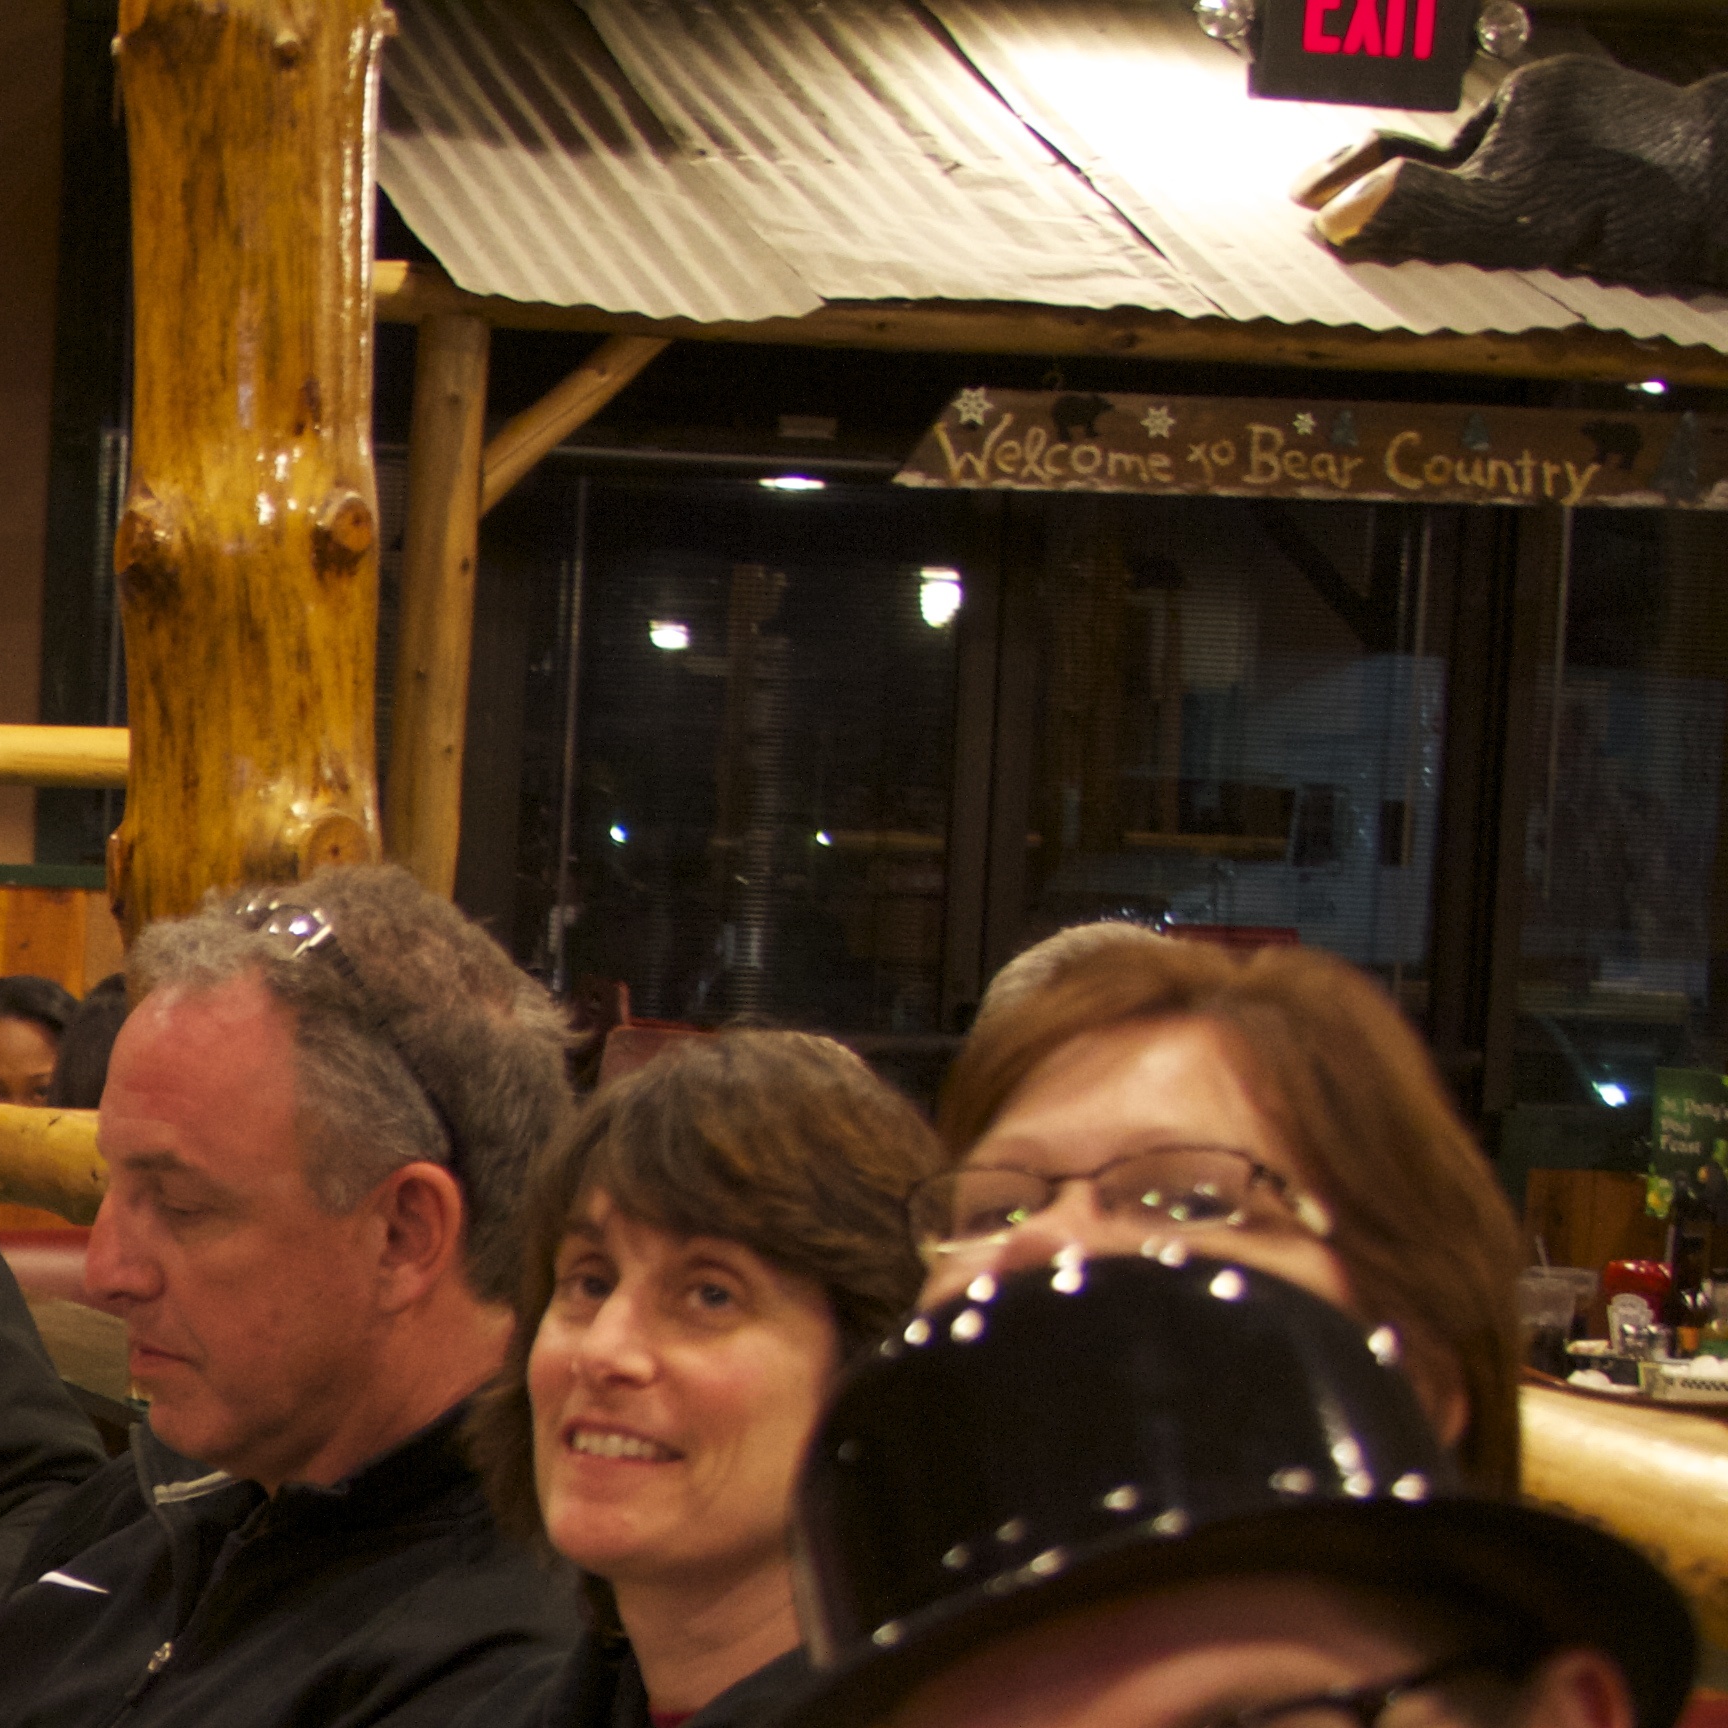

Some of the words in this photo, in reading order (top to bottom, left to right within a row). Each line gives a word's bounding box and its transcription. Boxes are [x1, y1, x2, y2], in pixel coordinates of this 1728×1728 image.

[1302, 0, 1437, 60] EXIT
[933, 412, 1174, 484] Welcome
[1244, 422, 1364, 487] Bear
[1384, 431, 1600, 505] Country
